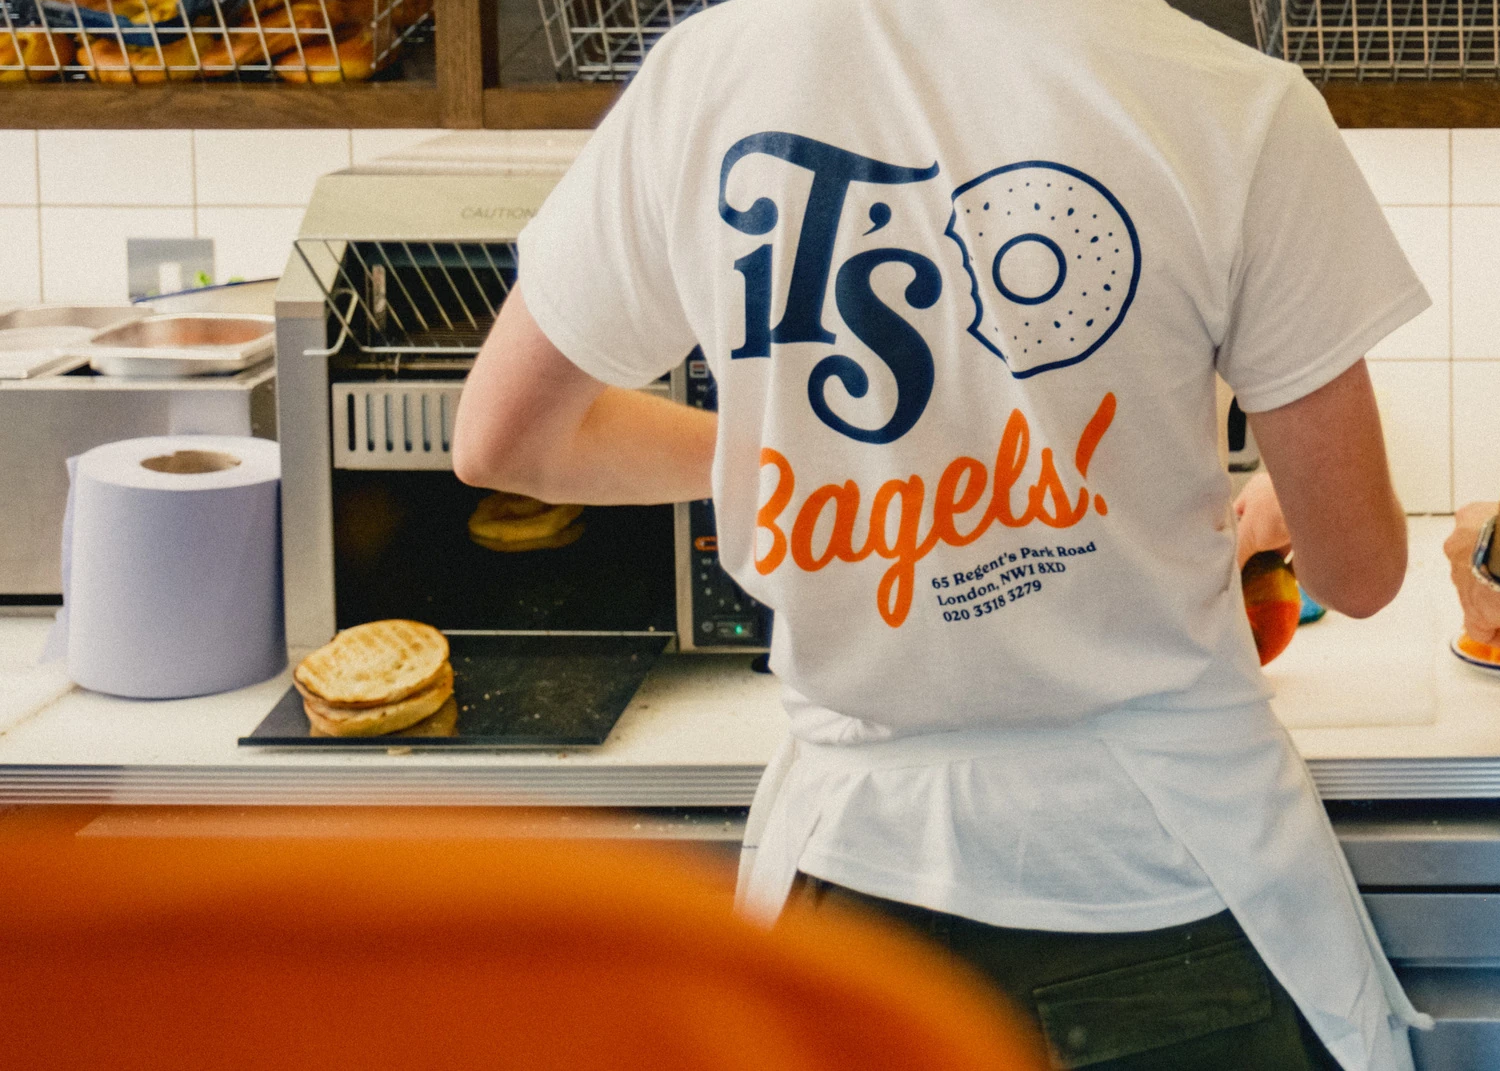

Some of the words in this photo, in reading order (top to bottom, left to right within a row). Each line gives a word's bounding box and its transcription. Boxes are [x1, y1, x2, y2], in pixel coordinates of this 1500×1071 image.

[931, 576, 950, 590] 65
[953, 552, 1017, 586] Regent's
[1020, 546, 1055, 559] Park
[1056, 541, 1097, 558] Road
[937, 581, 1000, 606] London,
[1000, 564, 1036, 586] NW1
[1038, 561, 1067, 575] 8XD
[943, 608, 970, 623] 020
[973, 595, 1007, 618] 3318
[1007, 579, 1042, 603] 3279
